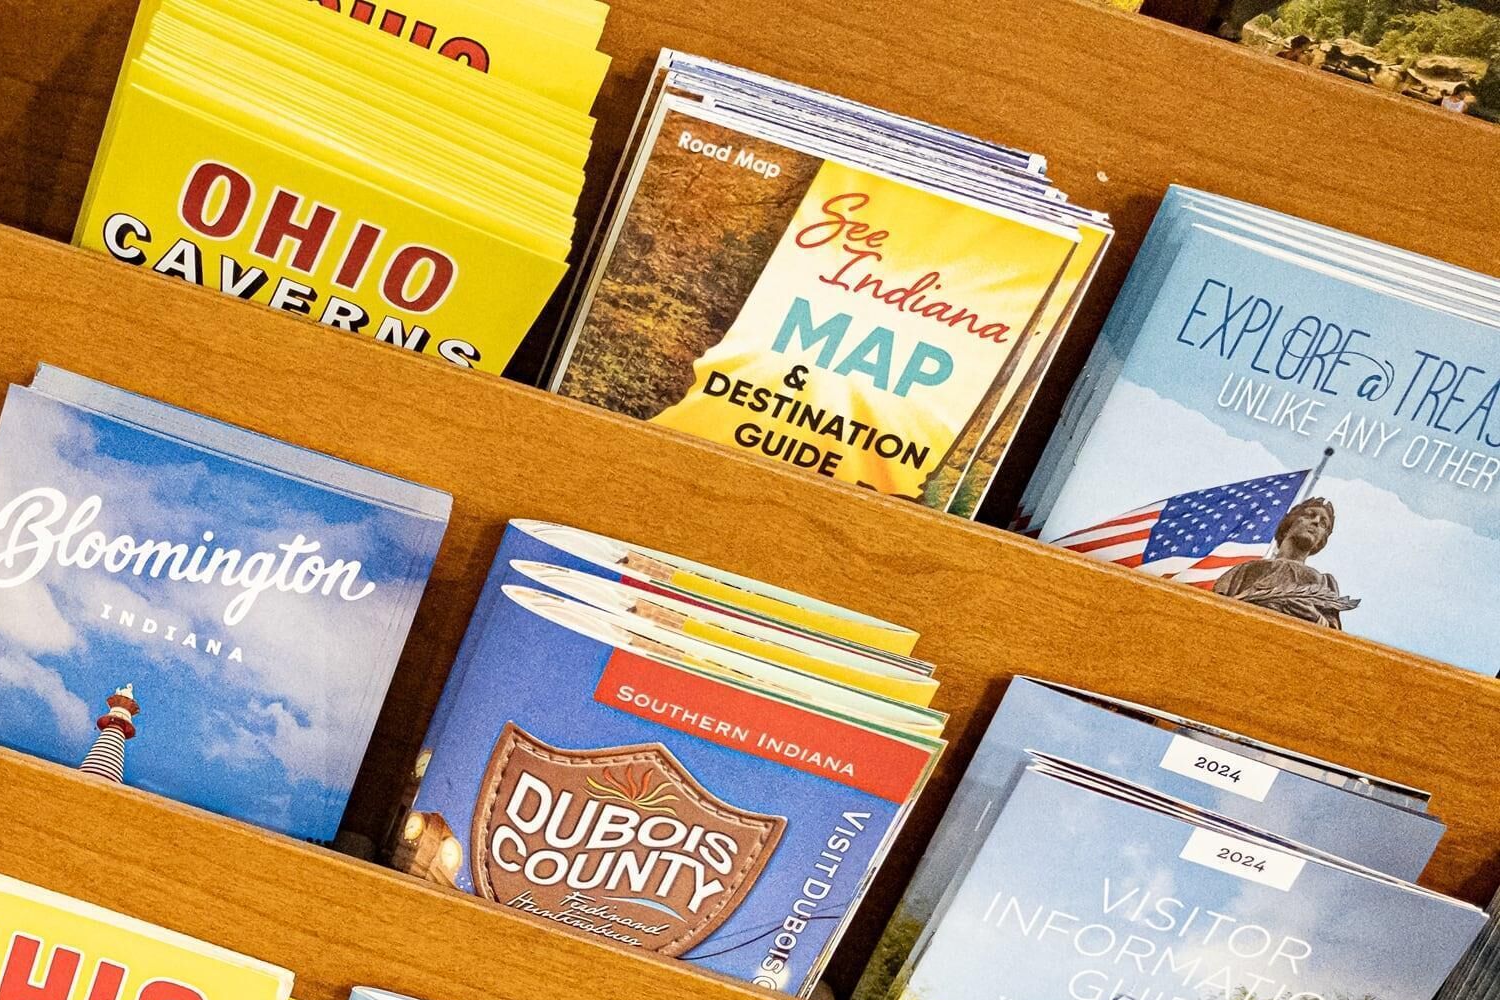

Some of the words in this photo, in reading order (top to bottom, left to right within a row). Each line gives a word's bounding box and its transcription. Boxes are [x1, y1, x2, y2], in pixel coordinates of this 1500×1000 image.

[678, 131, 732, 162] Road
[734, 151, 781, 180] Map
[178, 158, 459, 315] OHIO
[794, 193, 889, 248] See
[102, 213, 482, 369] CAVERNS
[819, 246, 1010, 345] Indiana
[1177, 278, 1371, 396] EXPLORE
[771, 297, 955, 399] MAP
[784, 365, 810, 391] &
[703, 371, 930, 469] DESTINATION
[733, 423, 843, 478] GUIDE
[1217, 371, 1325, 436] UNLIKE
[1325, 410, 1401, 460] ANY
[1402, 435, 1500, 493] OTHER
[100, 603, 244, 664] INDIANA
[615, 684, 748, 744] SOUTHERN
[757, 732, 856, 778] INDIANA
[1193, 756, 1242, 785] 2024
[506, 771, 739, 874] DUBOIS
[1216, 846, 1267, 874] 2024
[491, 826, 724, 914] COUNTY
[560, 891, 670, 936] Ferdinand
[1103, 877, 1312, 974] VISITOR
